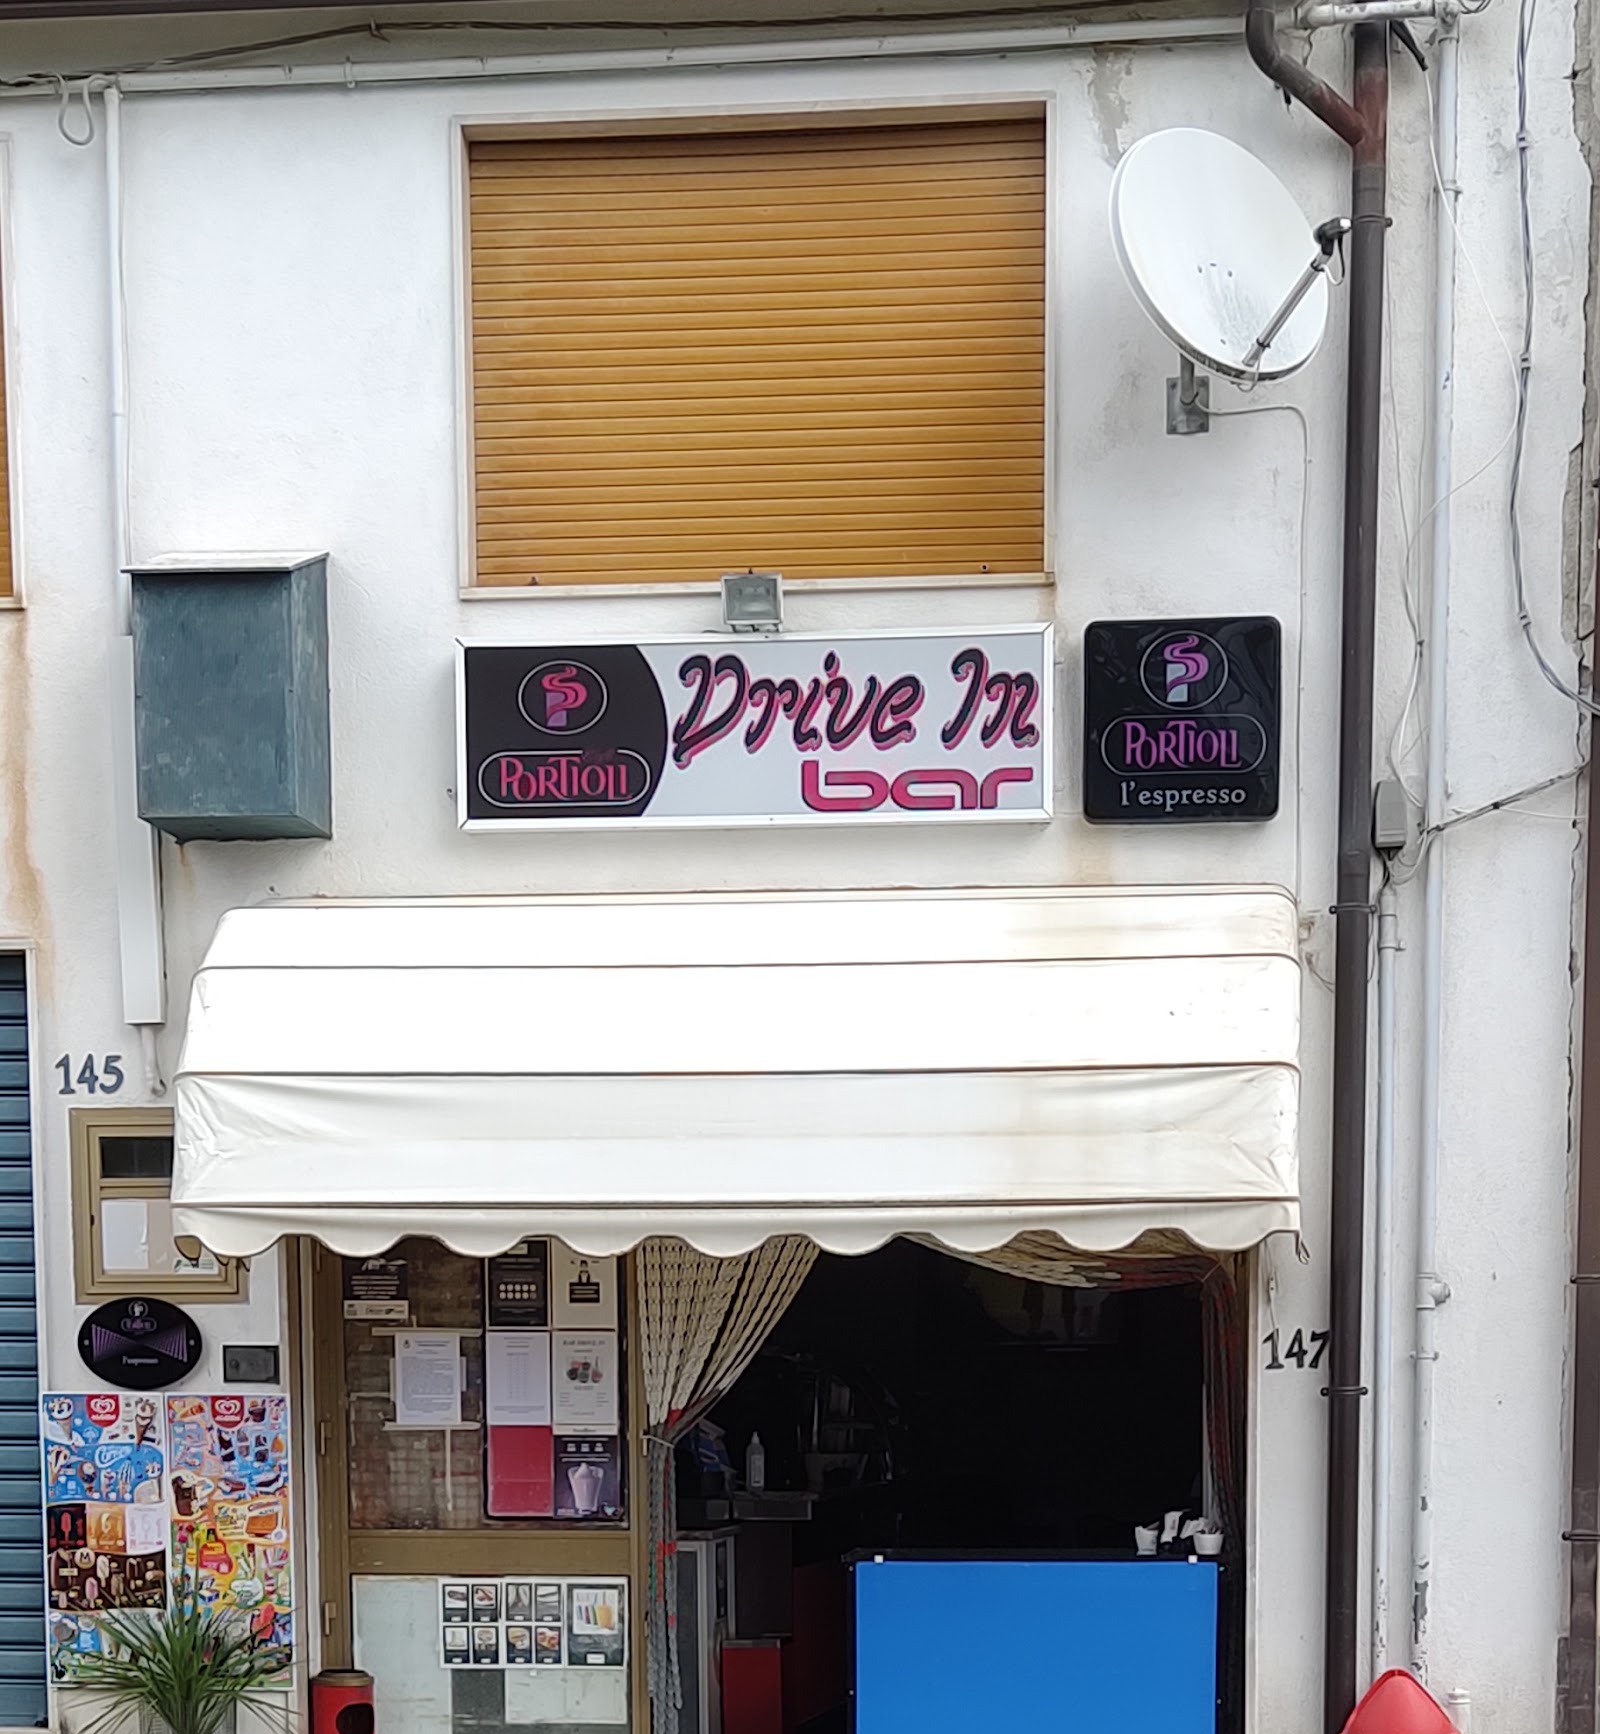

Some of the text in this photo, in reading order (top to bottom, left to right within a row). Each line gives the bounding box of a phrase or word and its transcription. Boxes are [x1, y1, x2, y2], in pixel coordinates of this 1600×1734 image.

[672, 647, 1041, 770] Drive In
[1123, 720, 1243, 770] PORTIOLI
[499, 756, 634, 802] PORTIOLI
[801, 759, 1034, 812] bar
[1120, 781, 1247, 812] l'espresso
[55, 1053, 125, 1095] 145
[1262, 1327, 1330, 1370] 147
